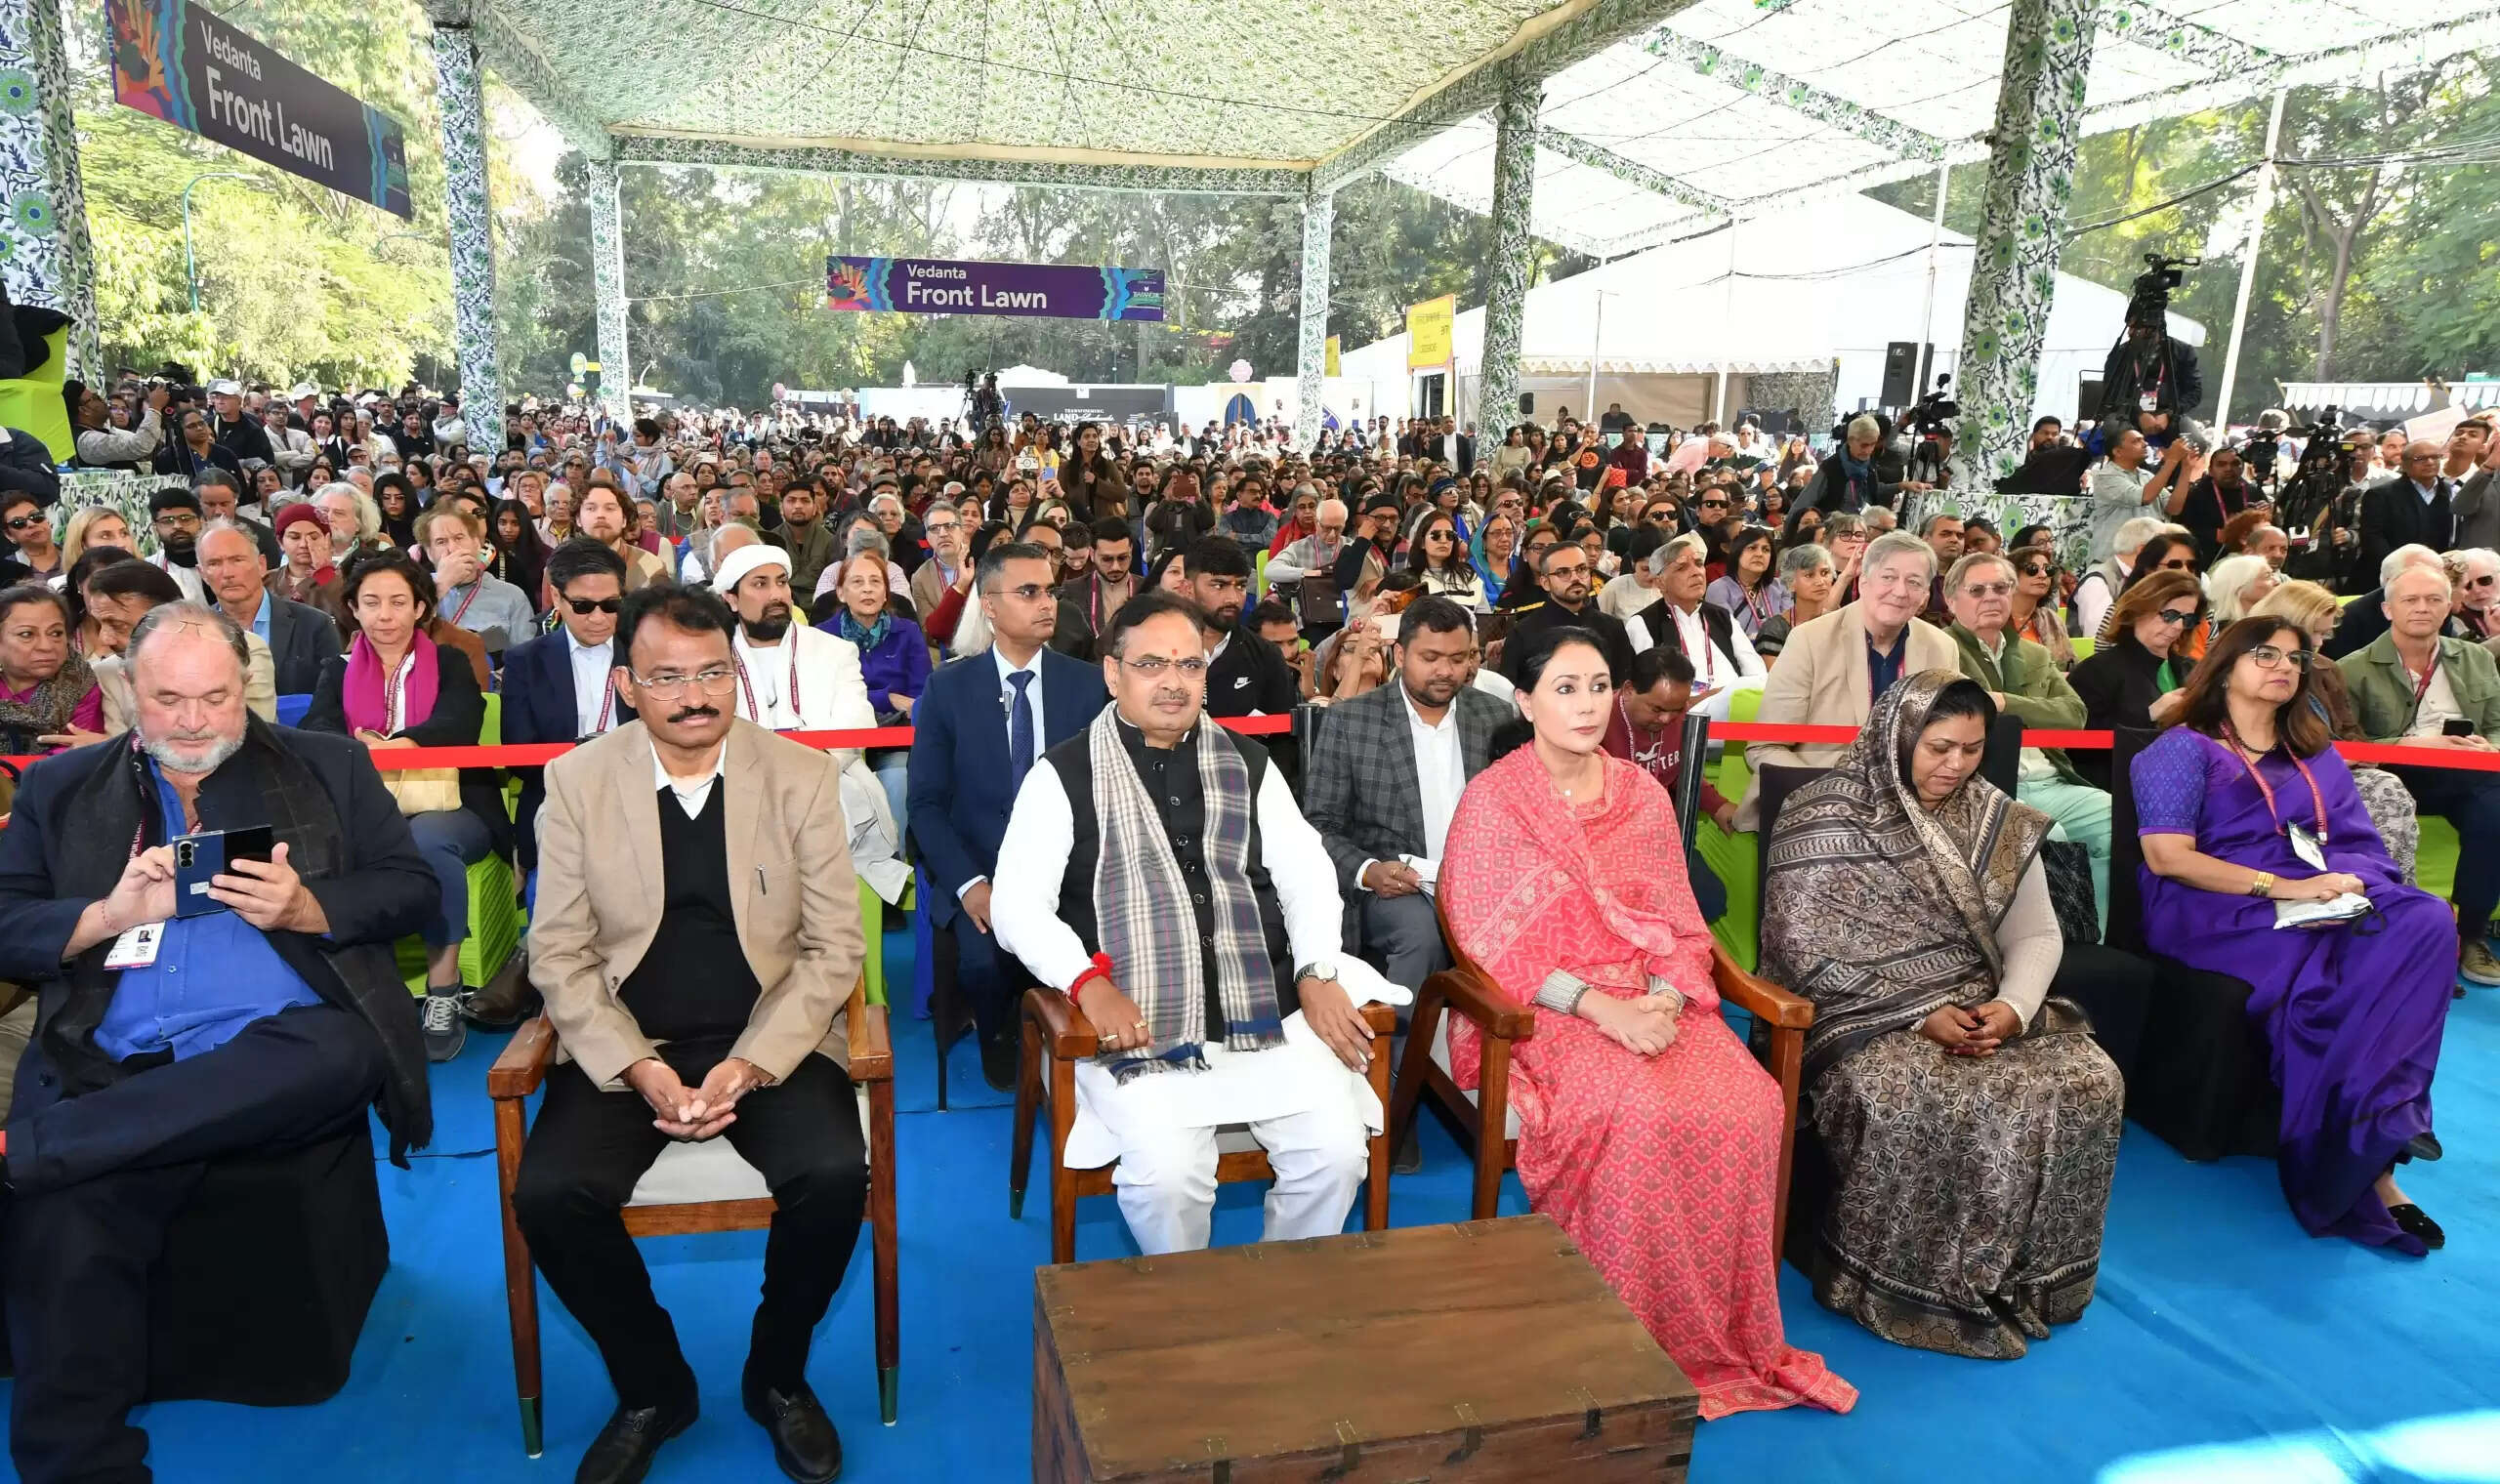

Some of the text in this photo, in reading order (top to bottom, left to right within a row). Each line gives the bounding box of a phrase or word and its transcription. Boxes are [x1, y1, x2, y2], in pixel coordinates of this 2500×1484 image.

[200, 21, 262, 81] Vedanta
[206, 65, 334, 171] Front Lawn
[906, 264, 967, 279] Vedanta
[907, 281, 1048, 309] Front Lawn
[1054, 413, 1078, 422] LAND
